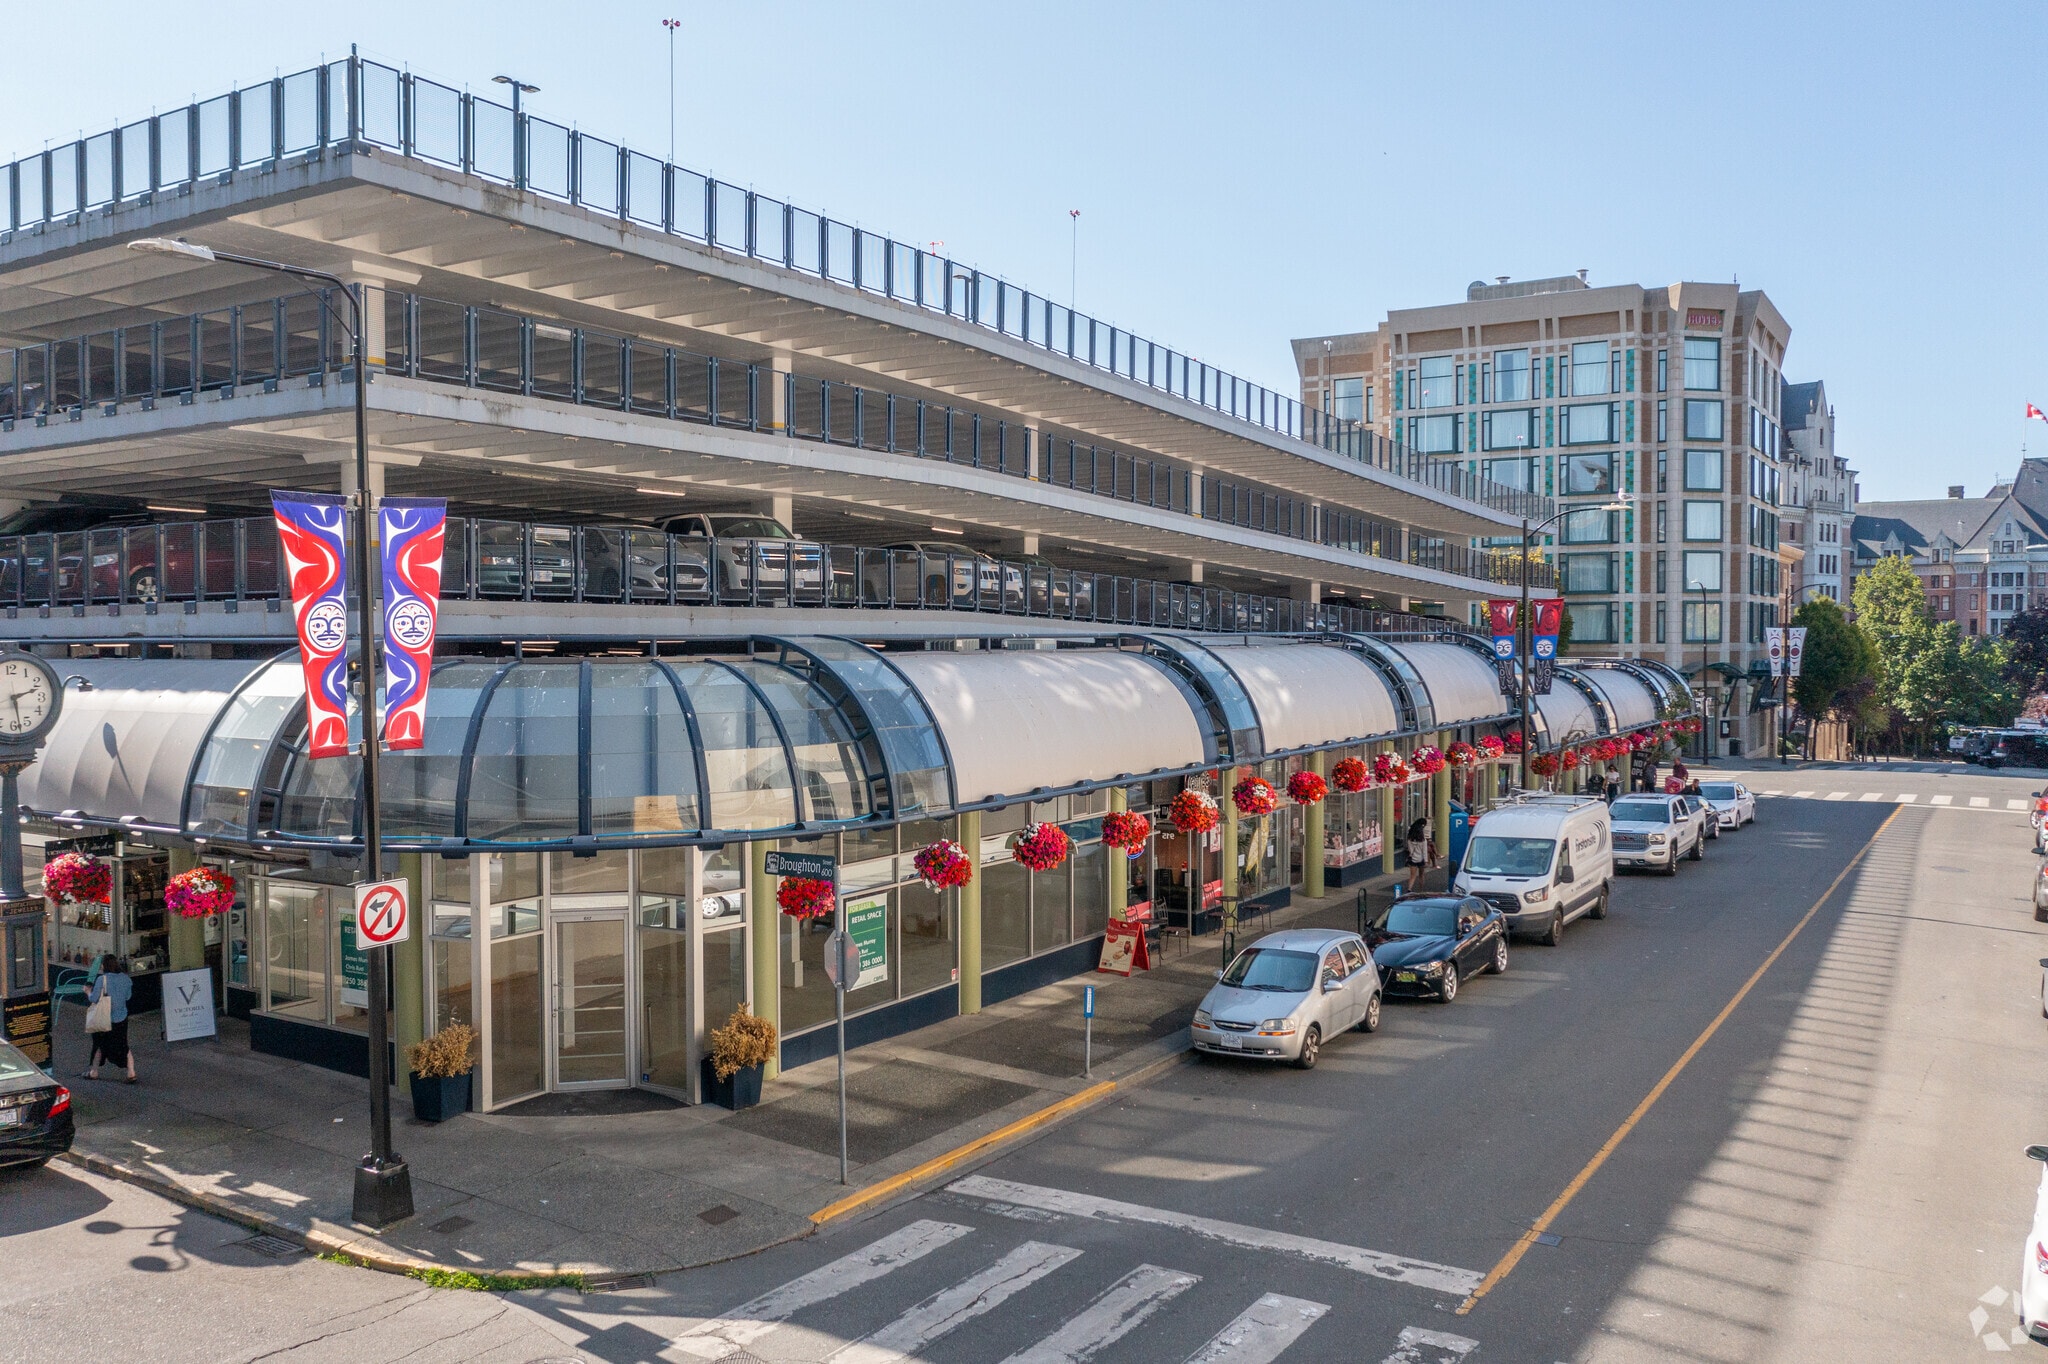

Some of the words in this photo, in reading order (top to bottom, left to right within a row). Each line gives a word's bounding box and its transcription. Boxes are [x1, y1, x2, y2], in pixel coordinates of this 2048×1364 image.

[1688, 314, 1721, 326] HOTEL
[5, 664, 17, 675] 12
[23, 668, 29, 678] 1
[33, 677, 41, 688] 2
[38, 692, 46, 703] 3
[34, 705, 43, 716] 4
[9, 721, 18, 731] 6
[23, 716, 32, 727] 5
[1455, 819, 1463, 828] P
[779, 857, 821, 875] Broughton
[820, 868, 833, 878] 600
[851, 914, 866, 925] RETAIL
[867, 910, 882, 920] SPACE
